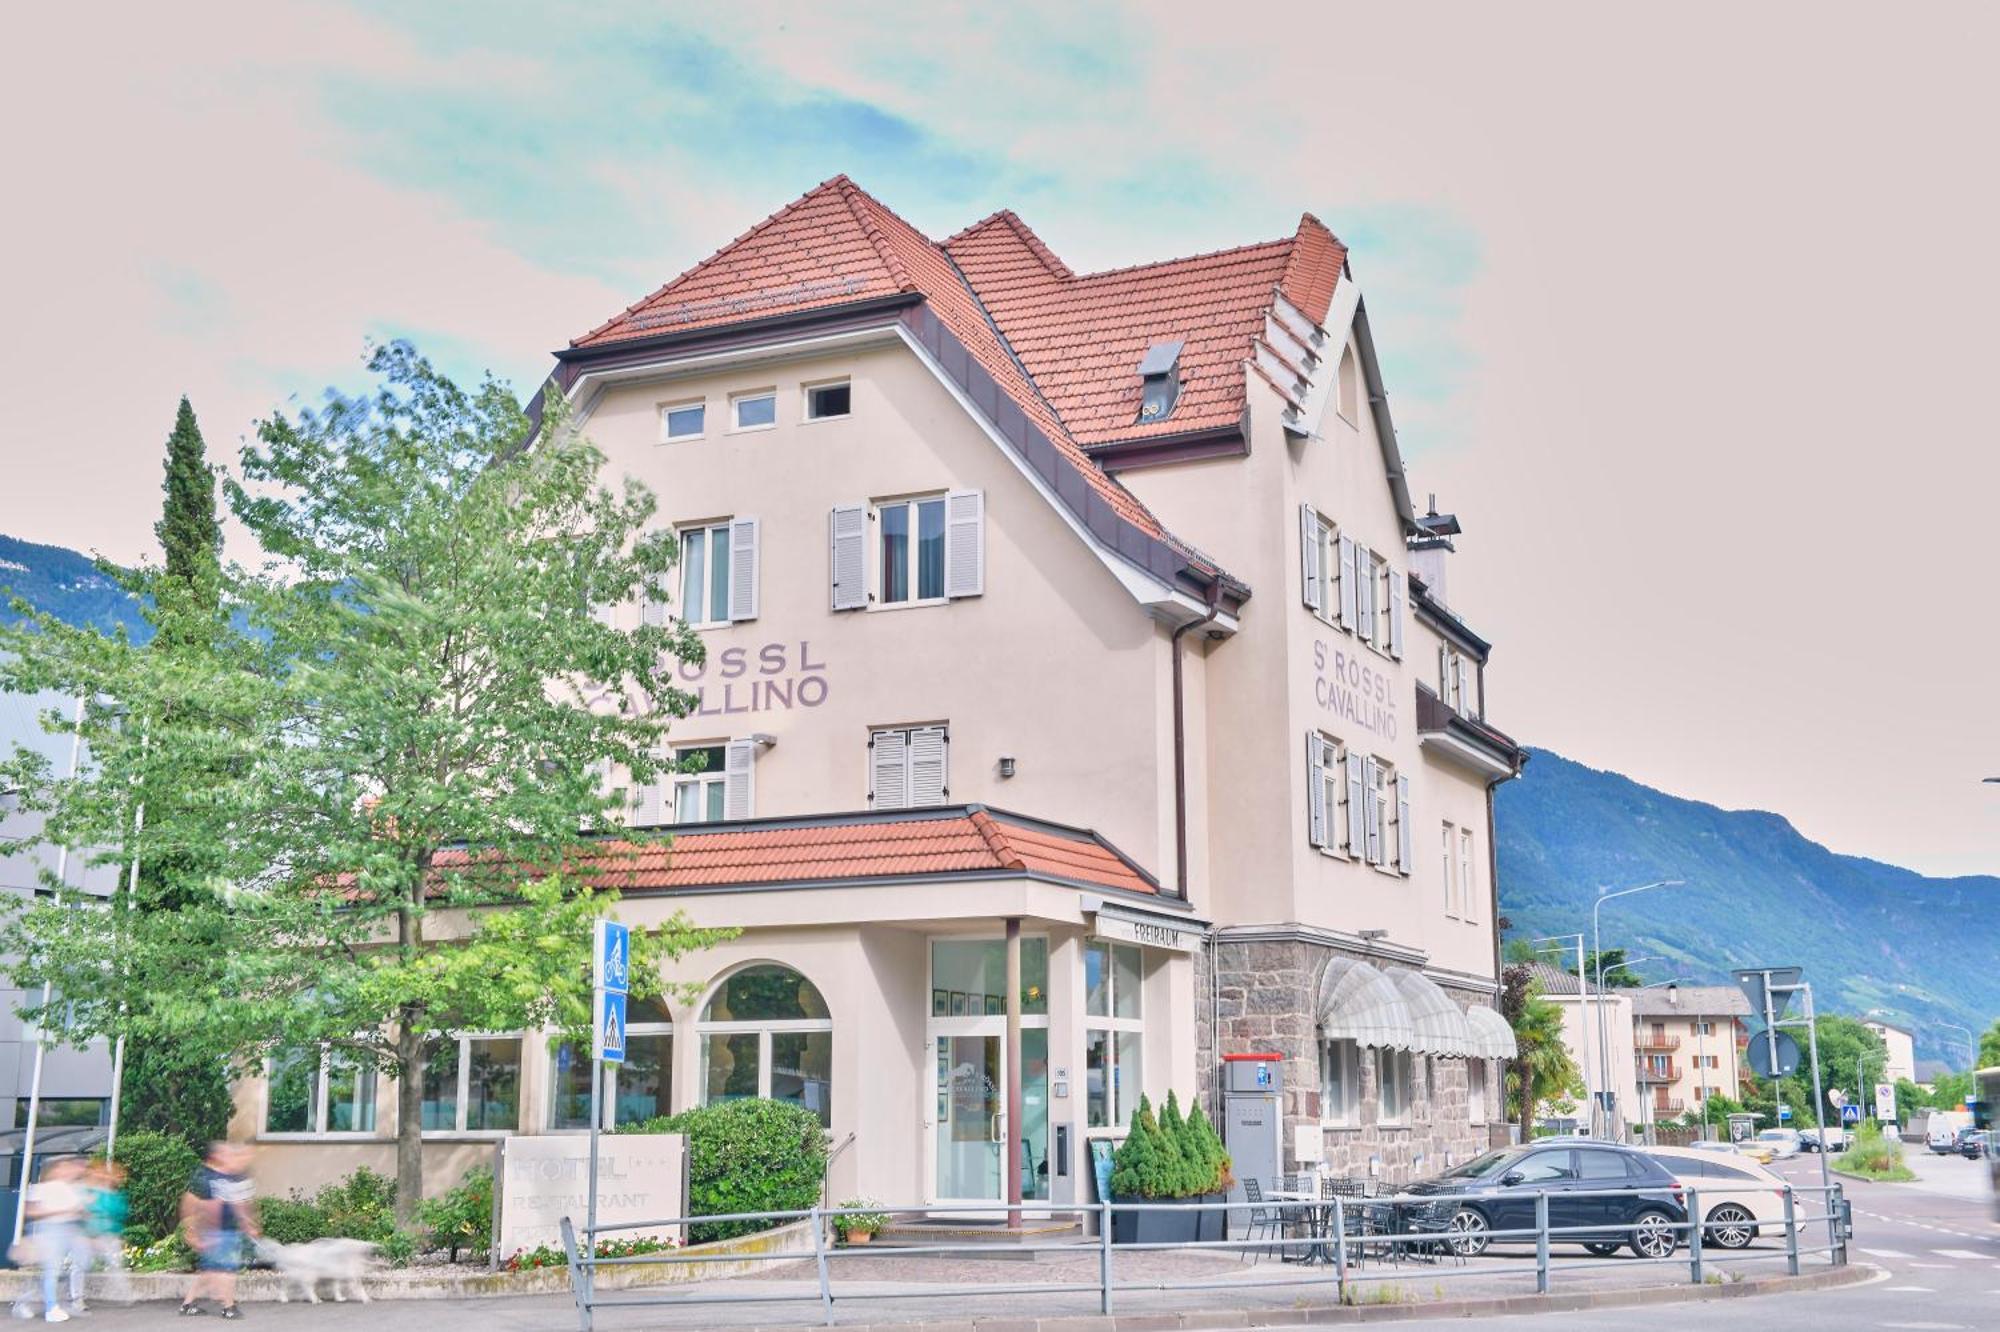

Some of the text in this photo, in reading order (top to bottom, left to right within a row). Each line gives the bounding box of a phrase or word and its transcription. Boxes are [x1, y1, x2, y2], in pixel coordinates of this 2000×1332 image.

[585, 675, 830, 719] ALLINO
[1315, 676, 1397, 742] CAVALLINO
[1134, 922, 1178, 947] FREIRAUM
